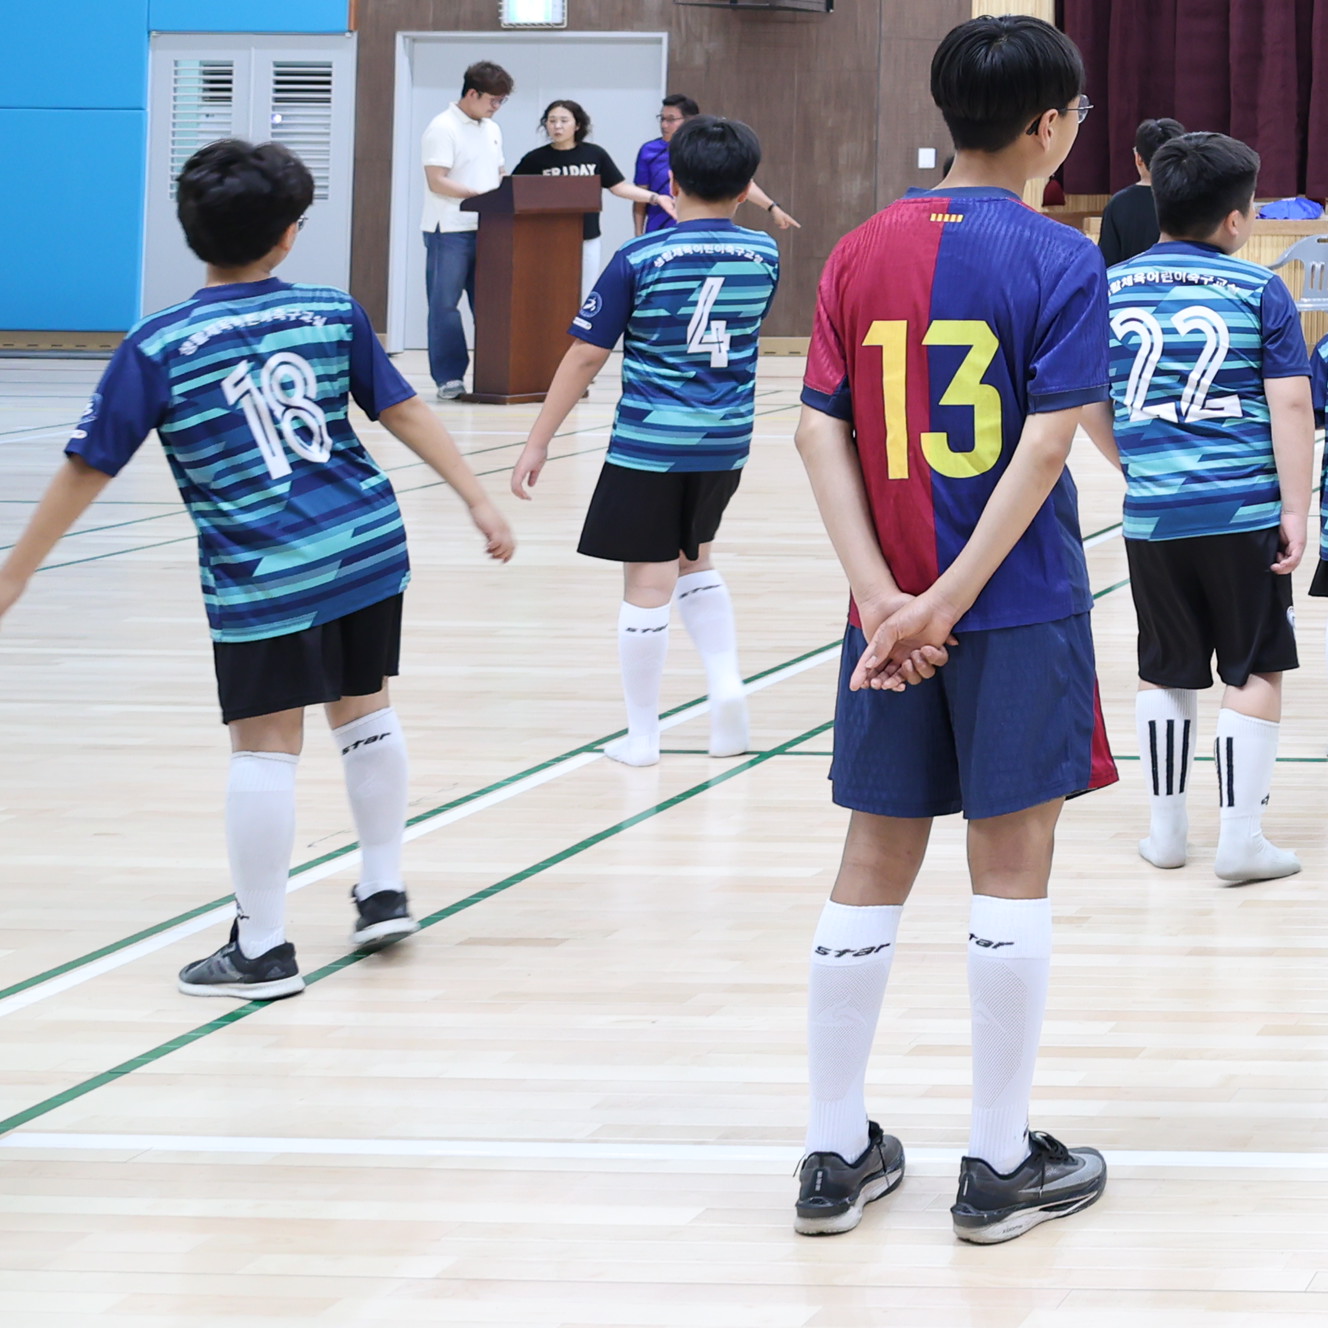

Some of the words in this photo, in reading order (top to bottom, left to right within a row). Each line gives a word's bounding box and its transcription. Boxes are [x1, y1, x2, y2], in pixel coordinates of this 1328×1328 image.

[687, 276, 731, 368] 4
[1110, 305, 1243, 423] 22
[220, 351, 333, 480] 18
[861, 319, 1002, 479] 13
[342, 731, 392, 756] star
[815, 942, 892, 958] star
[969, 932, 1015, 950] tar
